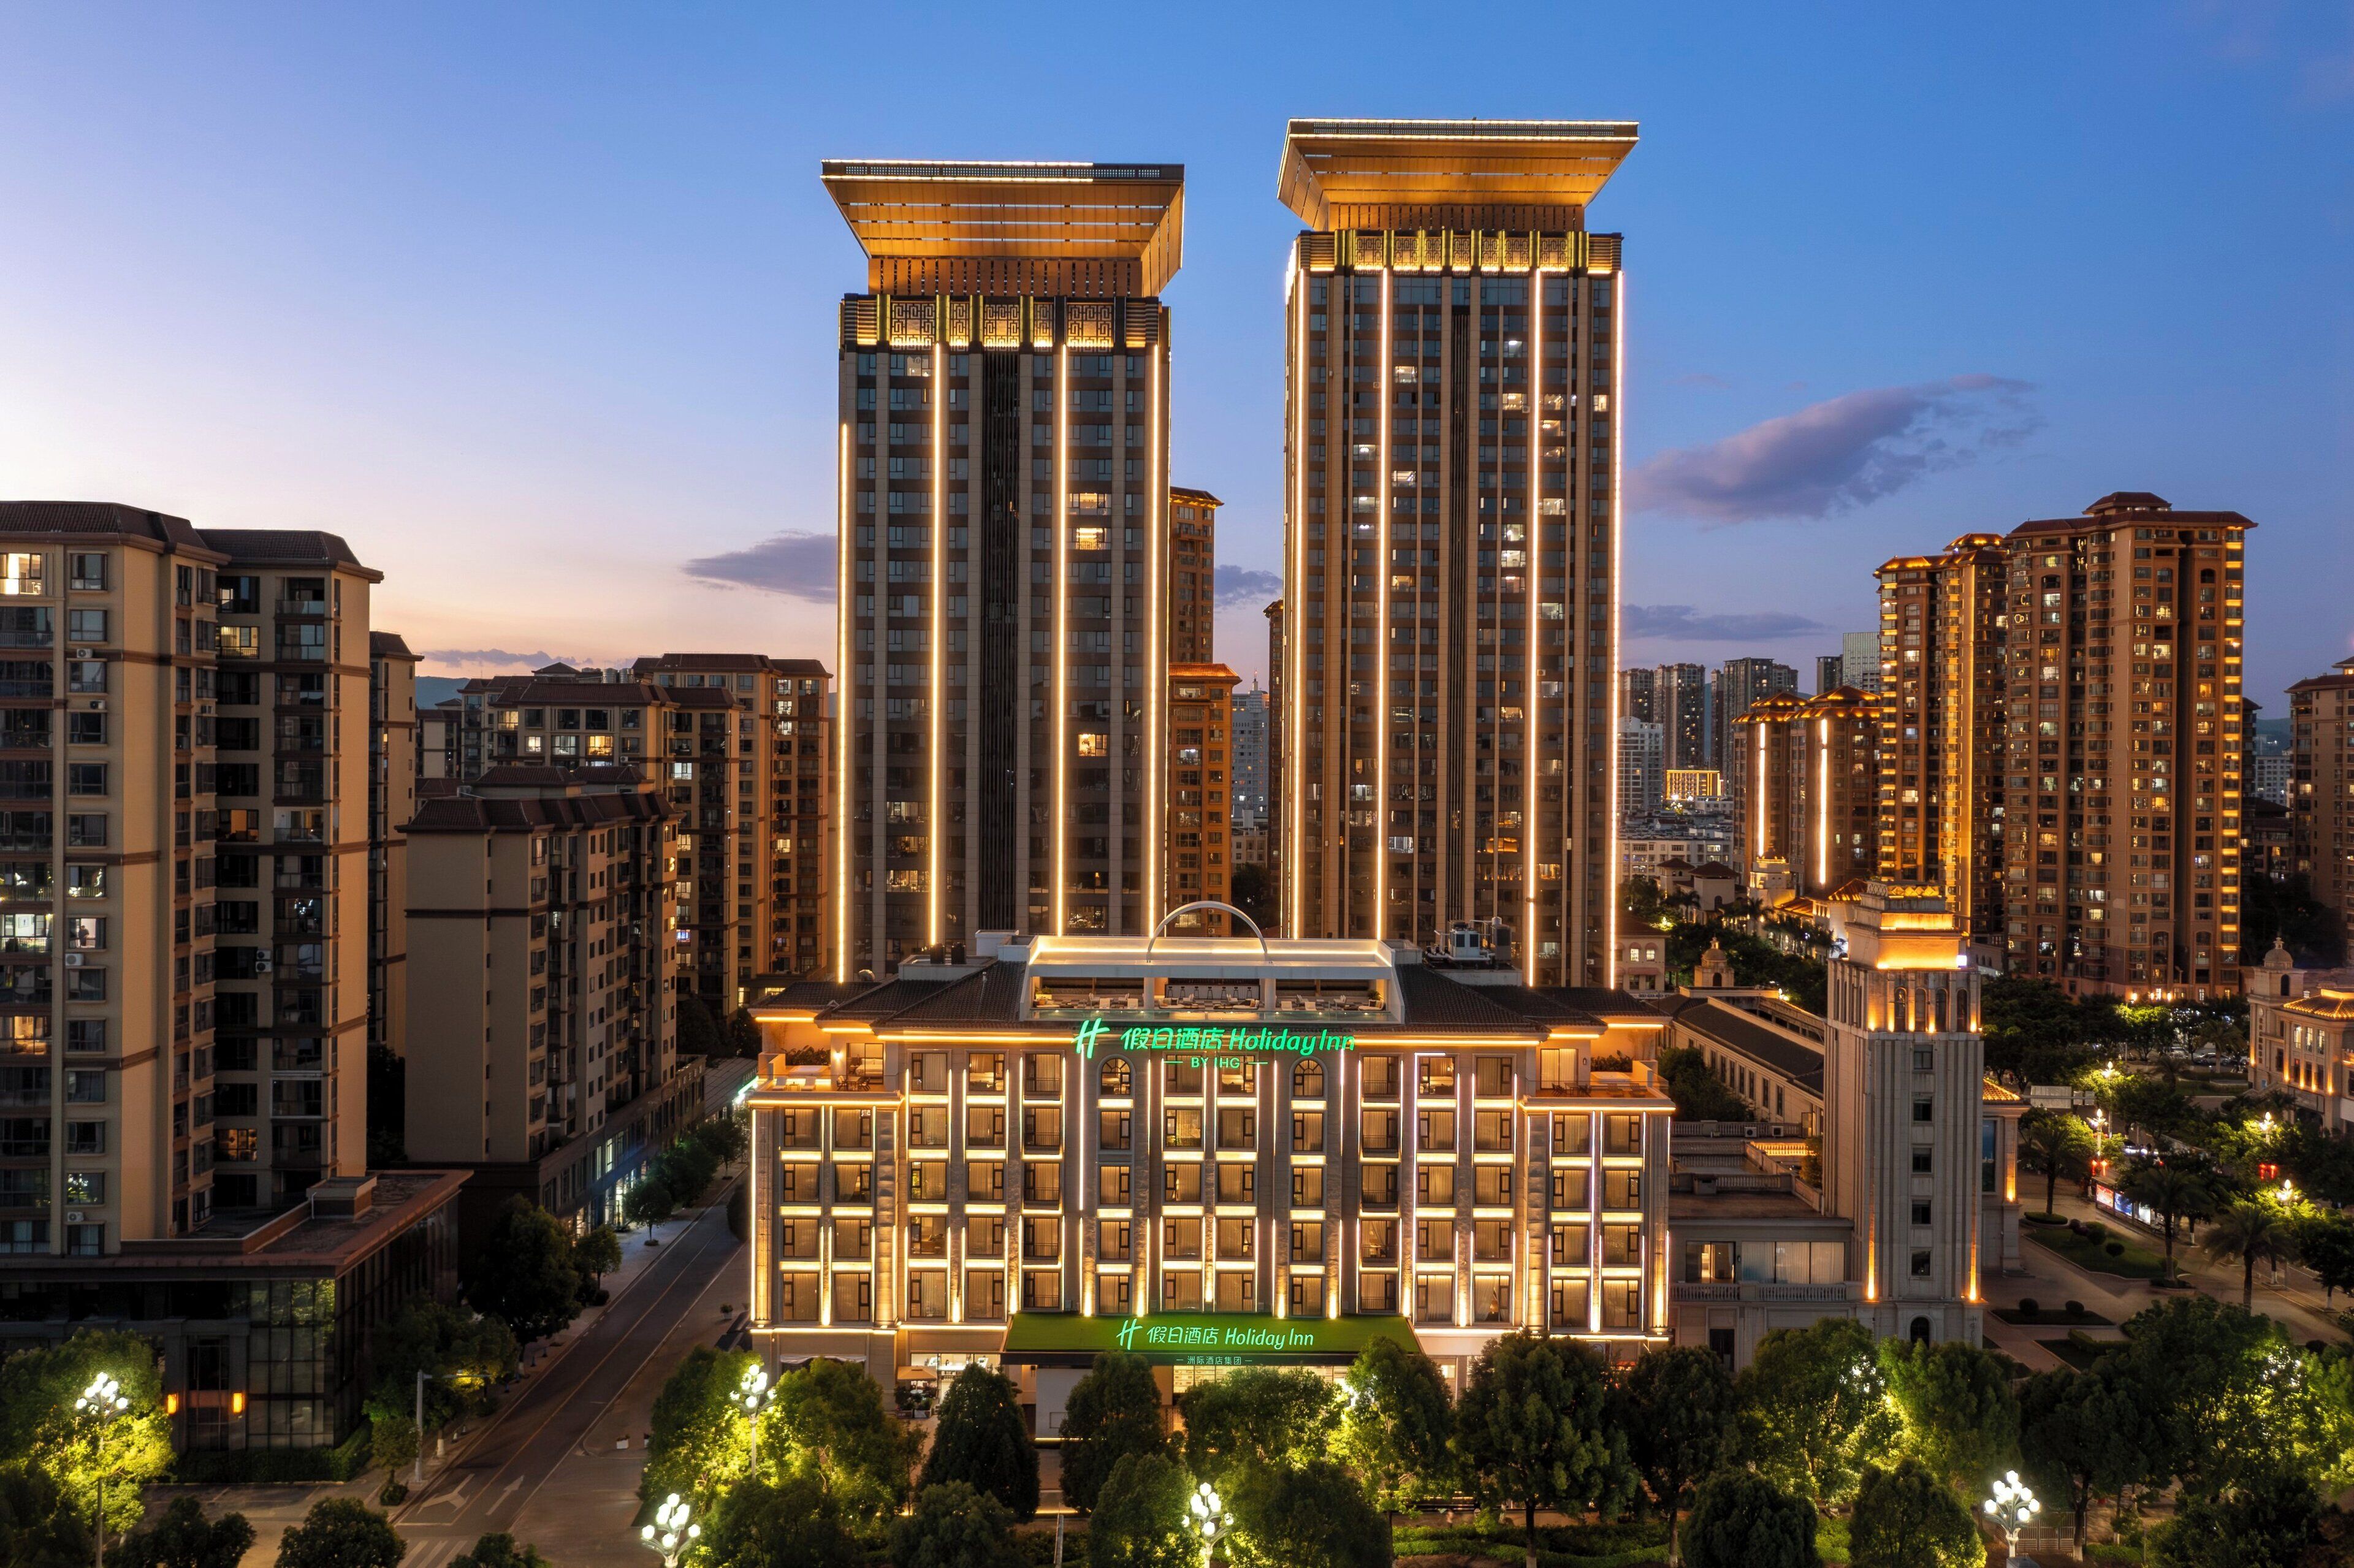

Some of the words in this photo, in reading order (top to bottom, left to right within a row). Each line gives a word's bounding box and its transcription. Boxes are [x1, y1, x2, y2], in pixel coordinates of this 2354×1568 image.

[1121, 1027, 1225, 1050] 假日酒店
[1229, 1027, 1316, 1056] Holiday
[1319, 1029, 1355, 1051] Inn
[1191, 1057, 1209, 1068] BY
[1214, 1057, 1240, 1068] IHG
[1146, 1326, 1220, 1345] 假日酒店
[1225, 1327, 1286, 1350] Holiday
[1289, 1328, 1314, 1346] Inn
[1187, 1355, 1242, 1365] 洲际酒店集团
